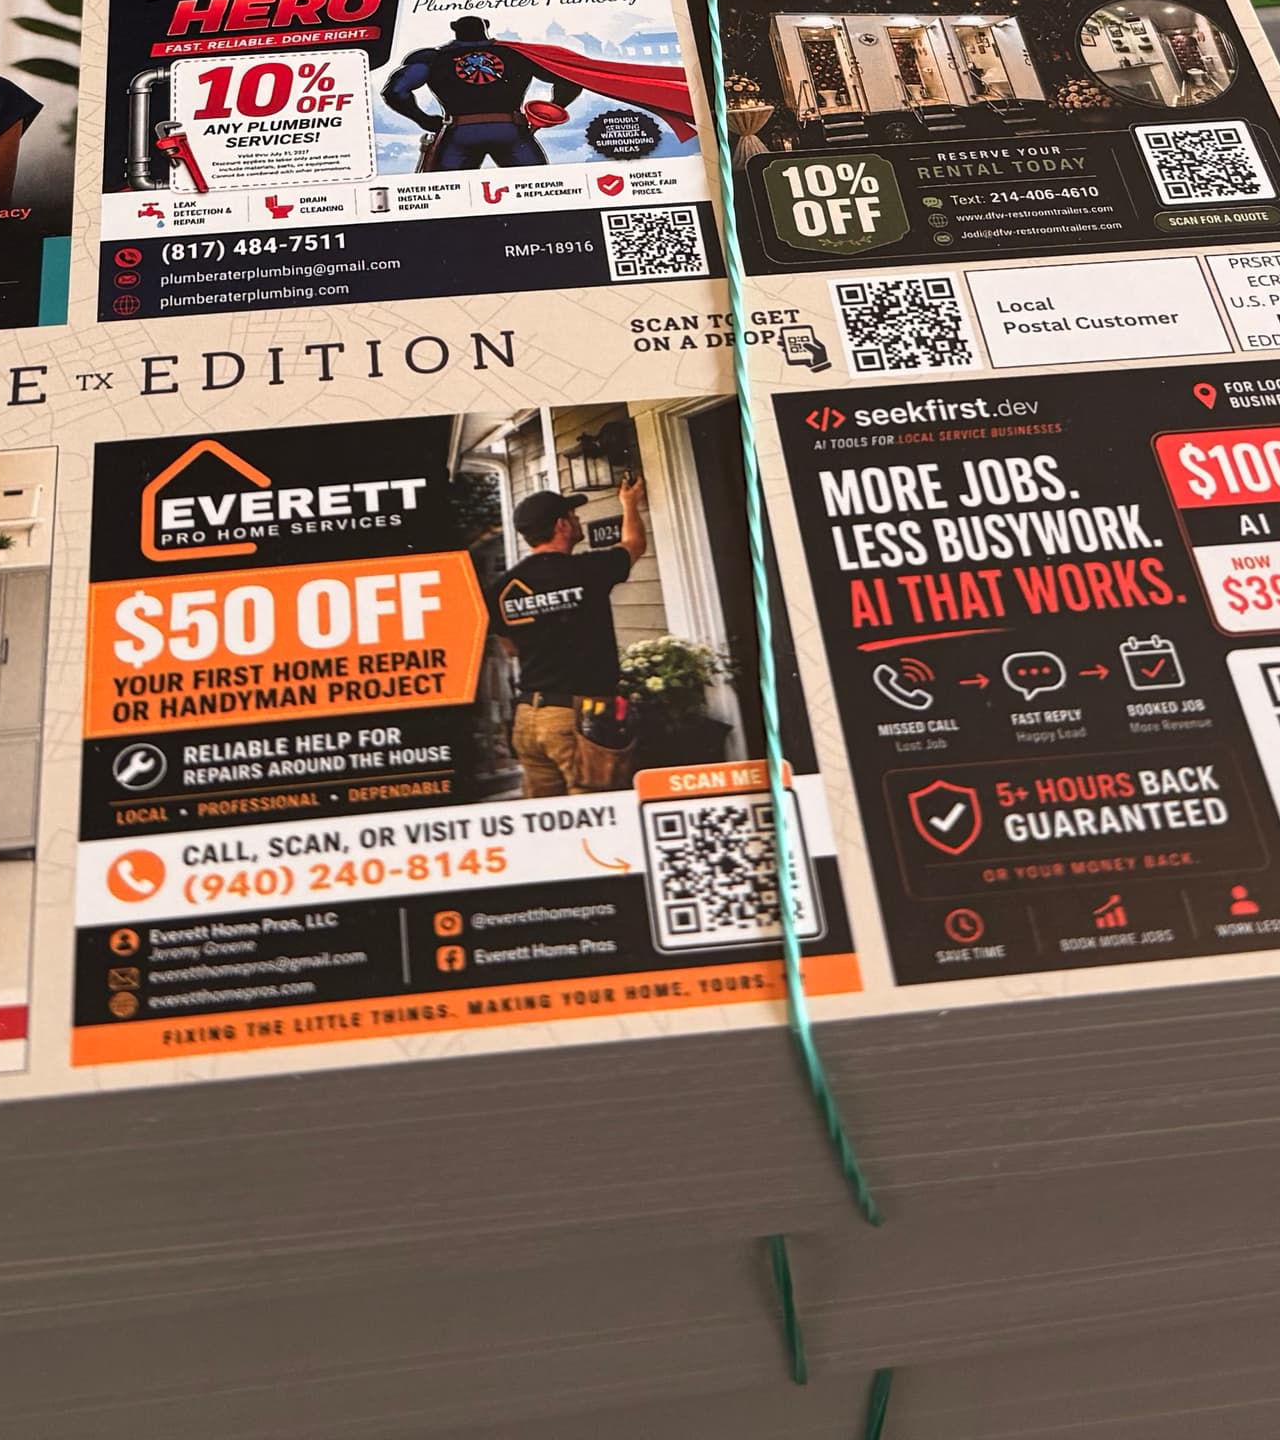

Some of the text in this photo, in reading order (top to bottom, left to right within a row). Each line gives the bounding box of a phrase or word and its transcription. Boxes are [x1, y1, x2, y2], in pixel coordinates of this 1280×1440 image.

[164, 27, 371, 55] FAST. RELIABLE. DONE RIGHT.
[193, 61, 335, 121] 10%
[294, 92, 354, 113] OFF
[203, 115, 342, 136] ANY PLUMBING
[225, 131, 320, 148] SERVICES!
[781, 161, 879, 198] 10%
[949, 185, 1099, 208] Text: 214-406-4610
[792, 196, 881, 238] OFF
[160, 232, 347, 265] (817) 484-7511
[504, 239, 595, 259] RMP-18916
[159, 258, 401, 288] plumberaterplumbing@gmail.com
[159, 282, 350, 310] plumberaterplumbing.com
[996, 296, 1055, 315] Local
[1001, 309, 1180, 337] Postal Customer
[76, 371, 114, 392] TX
[140, 328, 517, 396] EDITION
[853, 395, 1040, 429] seekfirst.dev
[819, 454, 1080, 518] MORE JOBS.
[160, 478, 427, 531] EVERETT
[160, 513, 403, 545] PRO HOME SERVICES
[592, 525, 621, 545] 1024
[831, 504, 1164, 570] LESS BUSYWORK.
[113, 570, 443, 670] $50 OFF
[183, 846, 510, 906] (940) 240-8145
